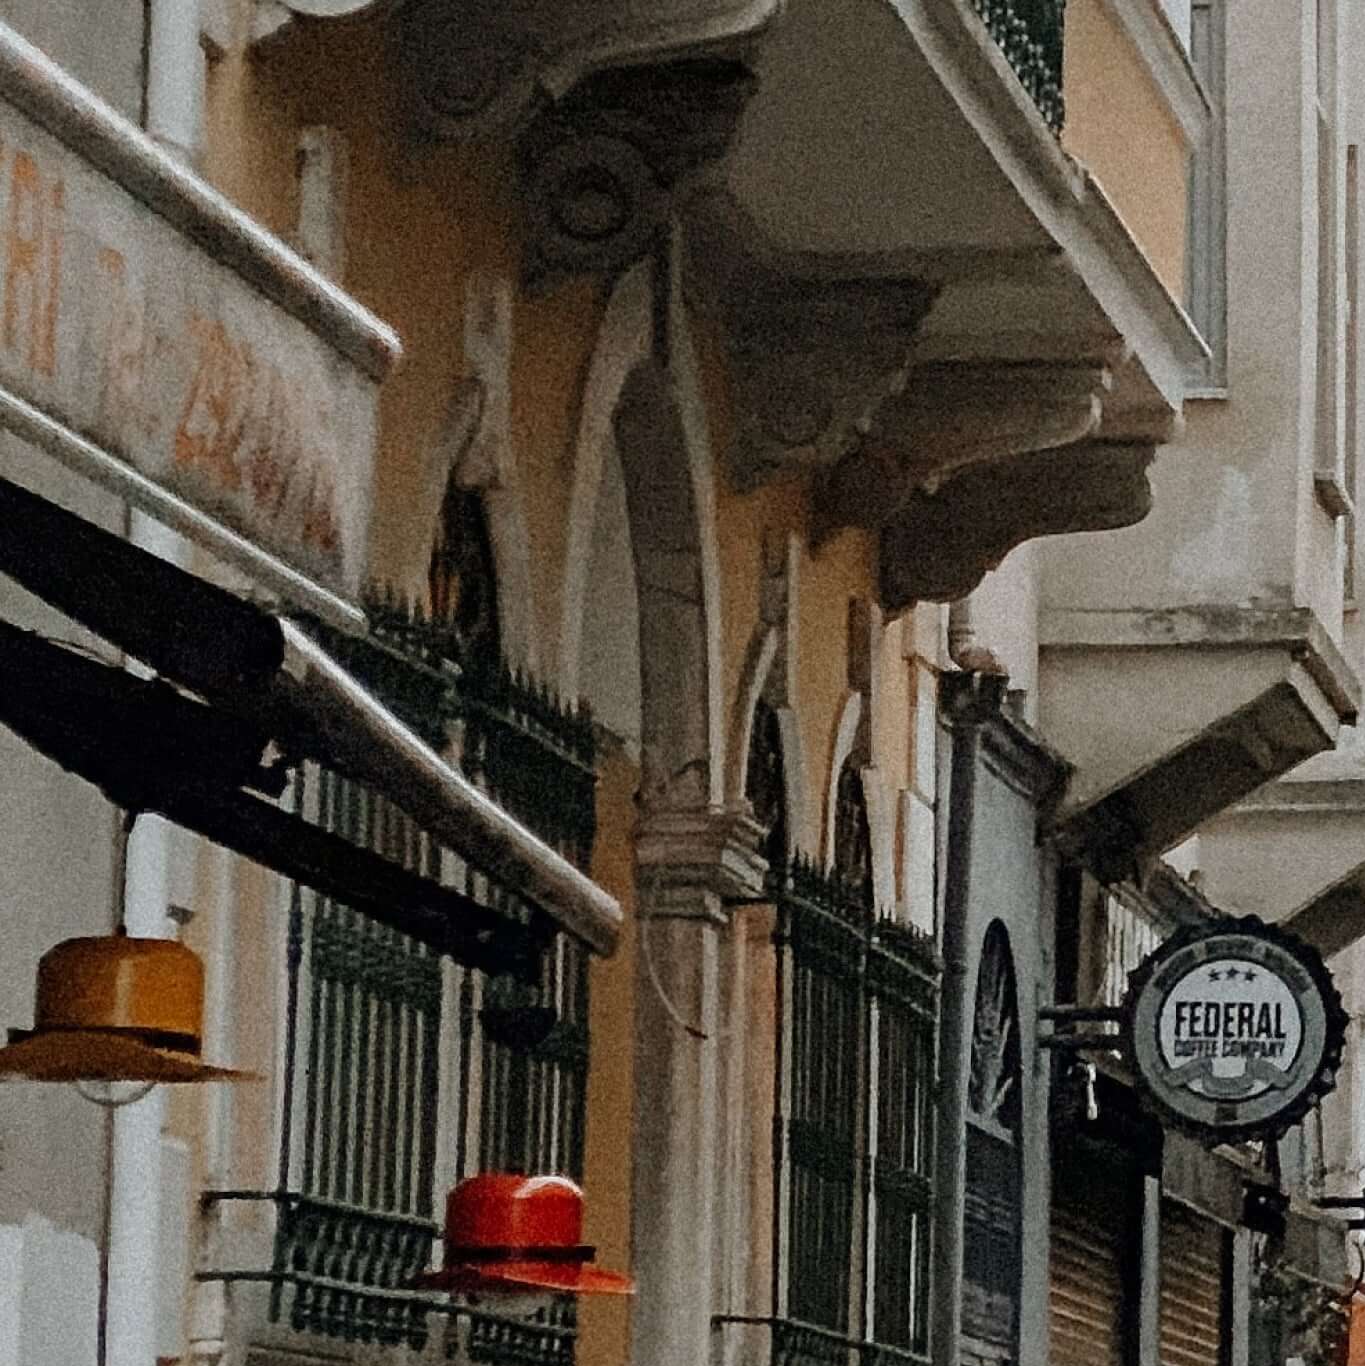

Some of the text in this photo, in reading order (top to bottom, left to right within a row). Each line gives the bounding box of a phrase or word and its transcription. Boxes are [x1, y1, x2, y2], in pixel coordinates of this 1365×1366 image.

[1174, 1001, 1287, 1039] FEDERAL
[1174, 1040, 1286, 1057] COFFEE COMPANY
